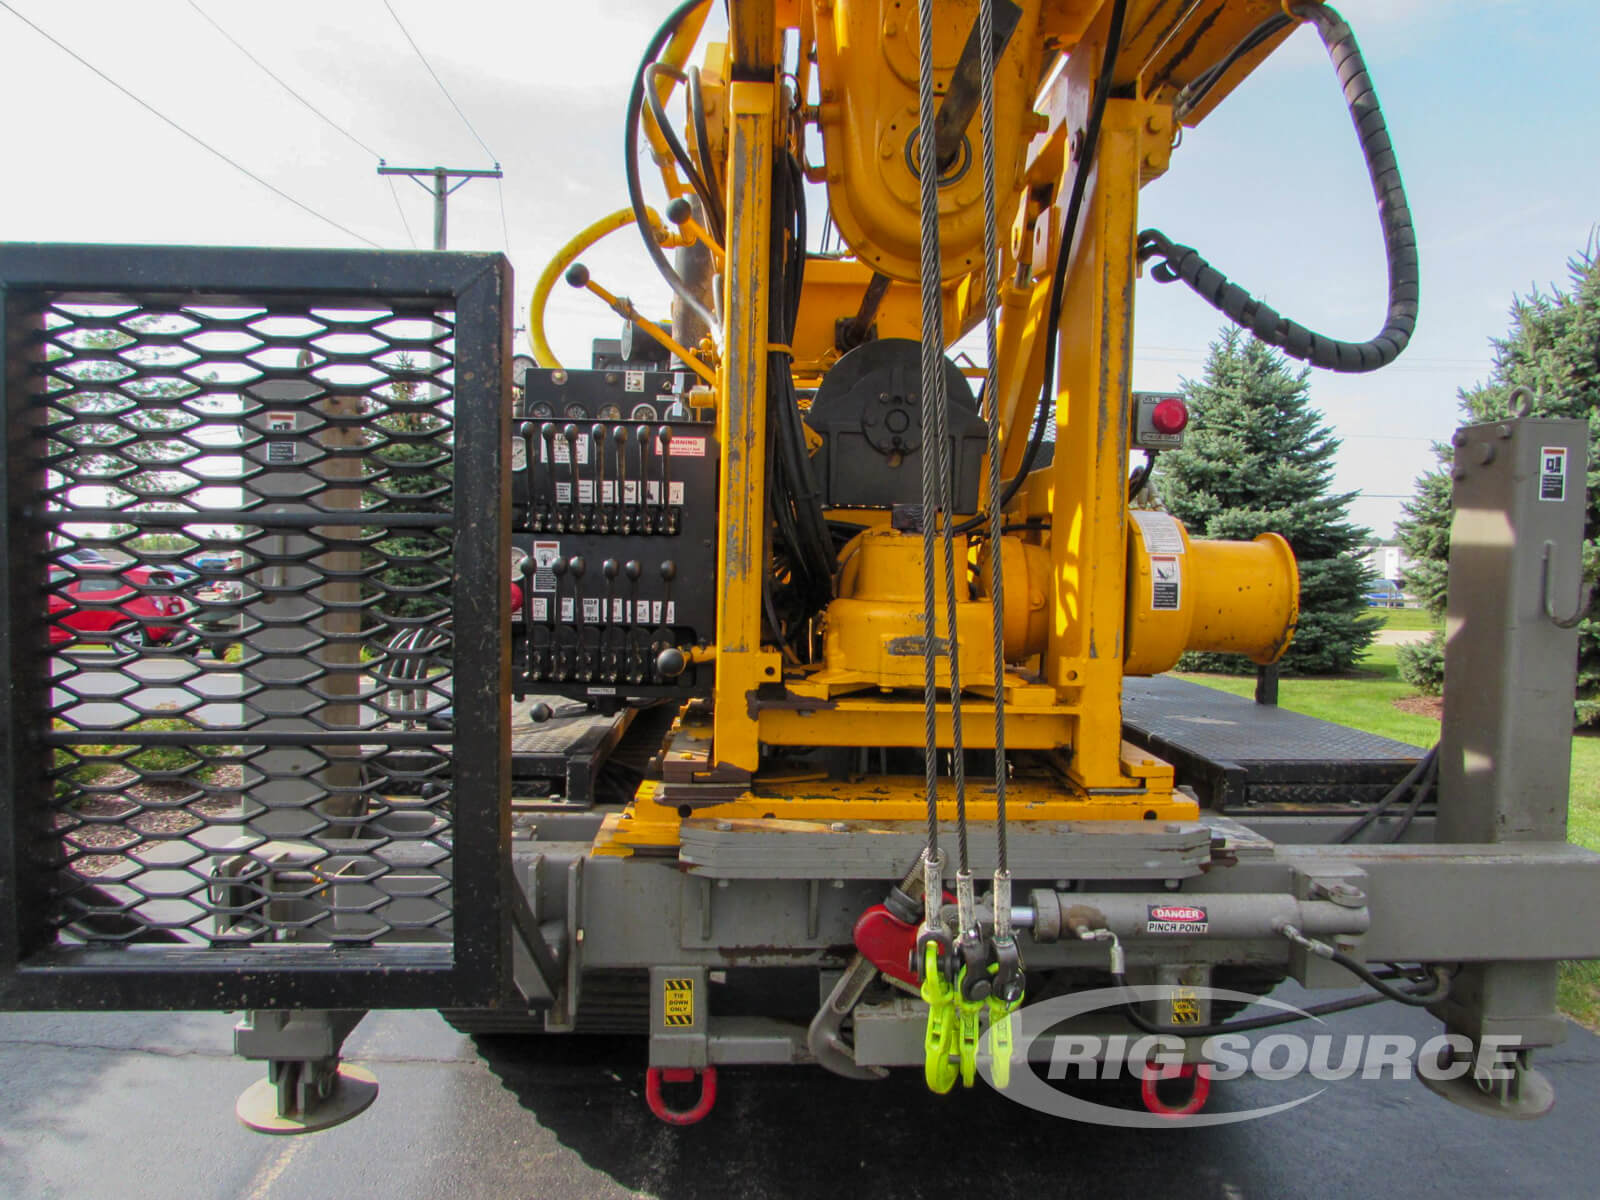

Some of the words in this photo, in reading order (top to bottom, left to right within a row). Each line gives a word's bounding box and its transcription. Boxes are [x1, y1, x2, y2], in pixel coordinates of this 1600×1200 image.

[1157, 909, 1198, 919] DANGER
[1149, 922, 1177, 932] PINCH
[1179, 923, 1206, 933] POINT
